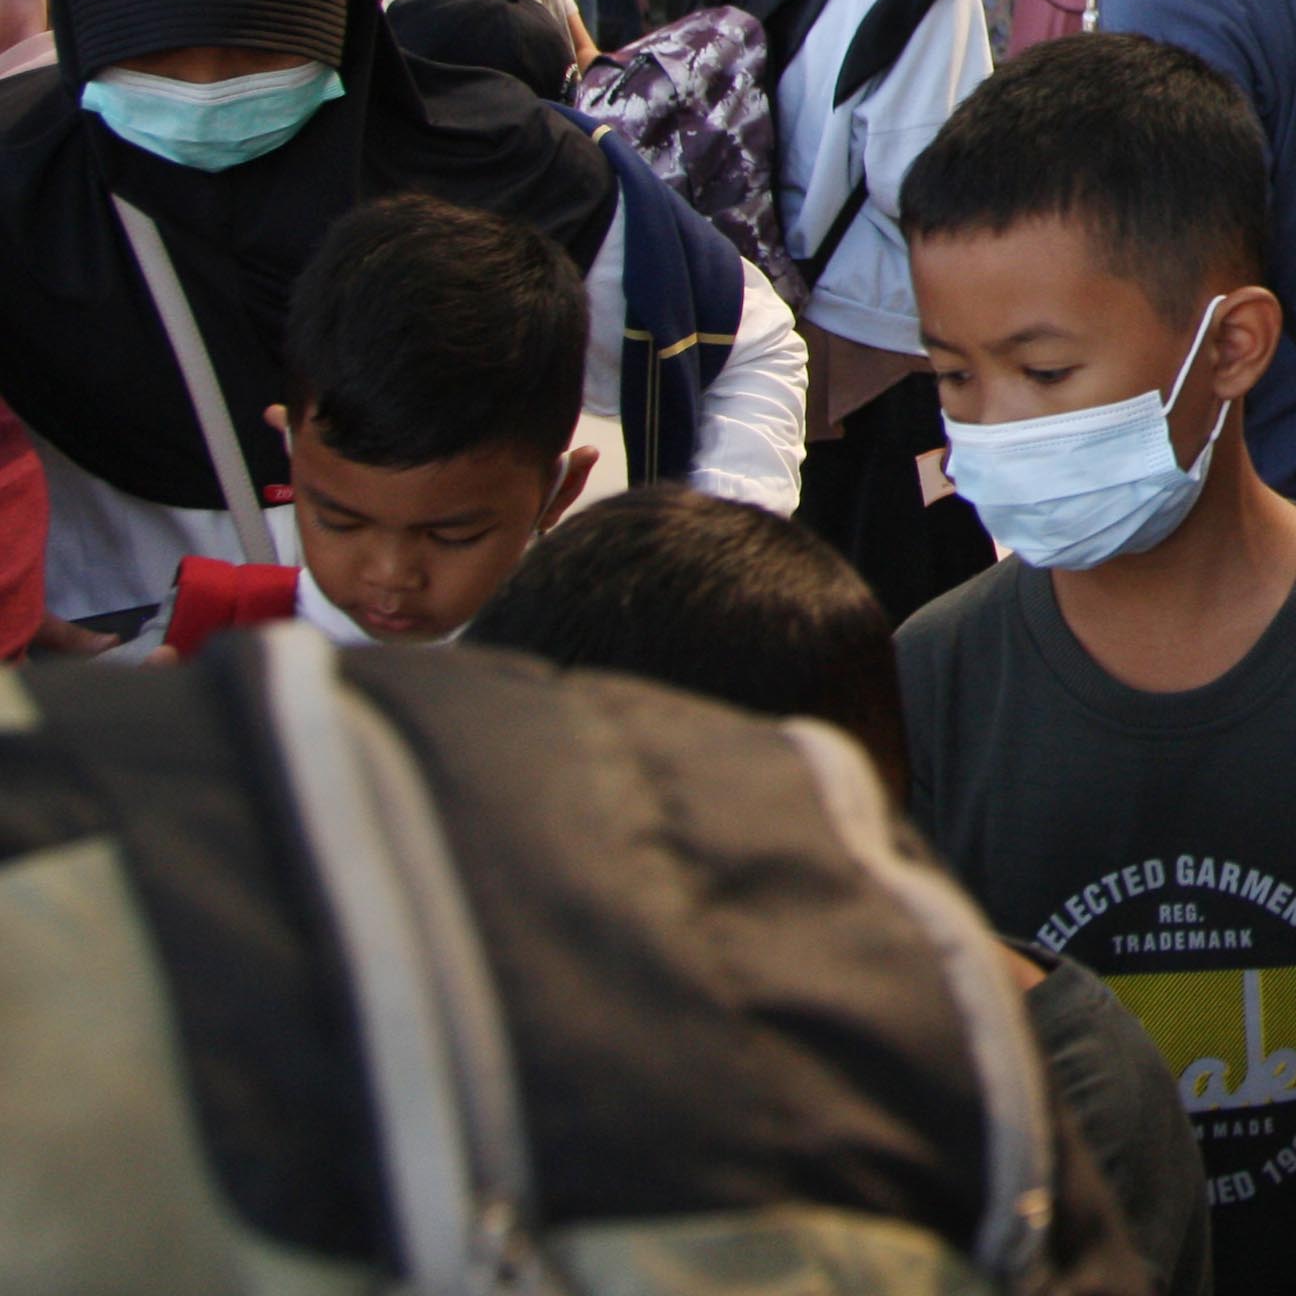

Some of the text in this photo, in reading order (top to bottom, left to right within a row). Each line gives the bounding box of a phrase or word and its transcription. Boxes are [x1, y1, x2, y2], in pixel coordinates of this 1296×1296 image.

[1031, 858, 1167, 954] ELECTED
[1158, 904, 1205, 923] REG.
[1112, 929, 1254, 955] TRADEMARK
[1212, 1117, 1276, 1138] MADE
